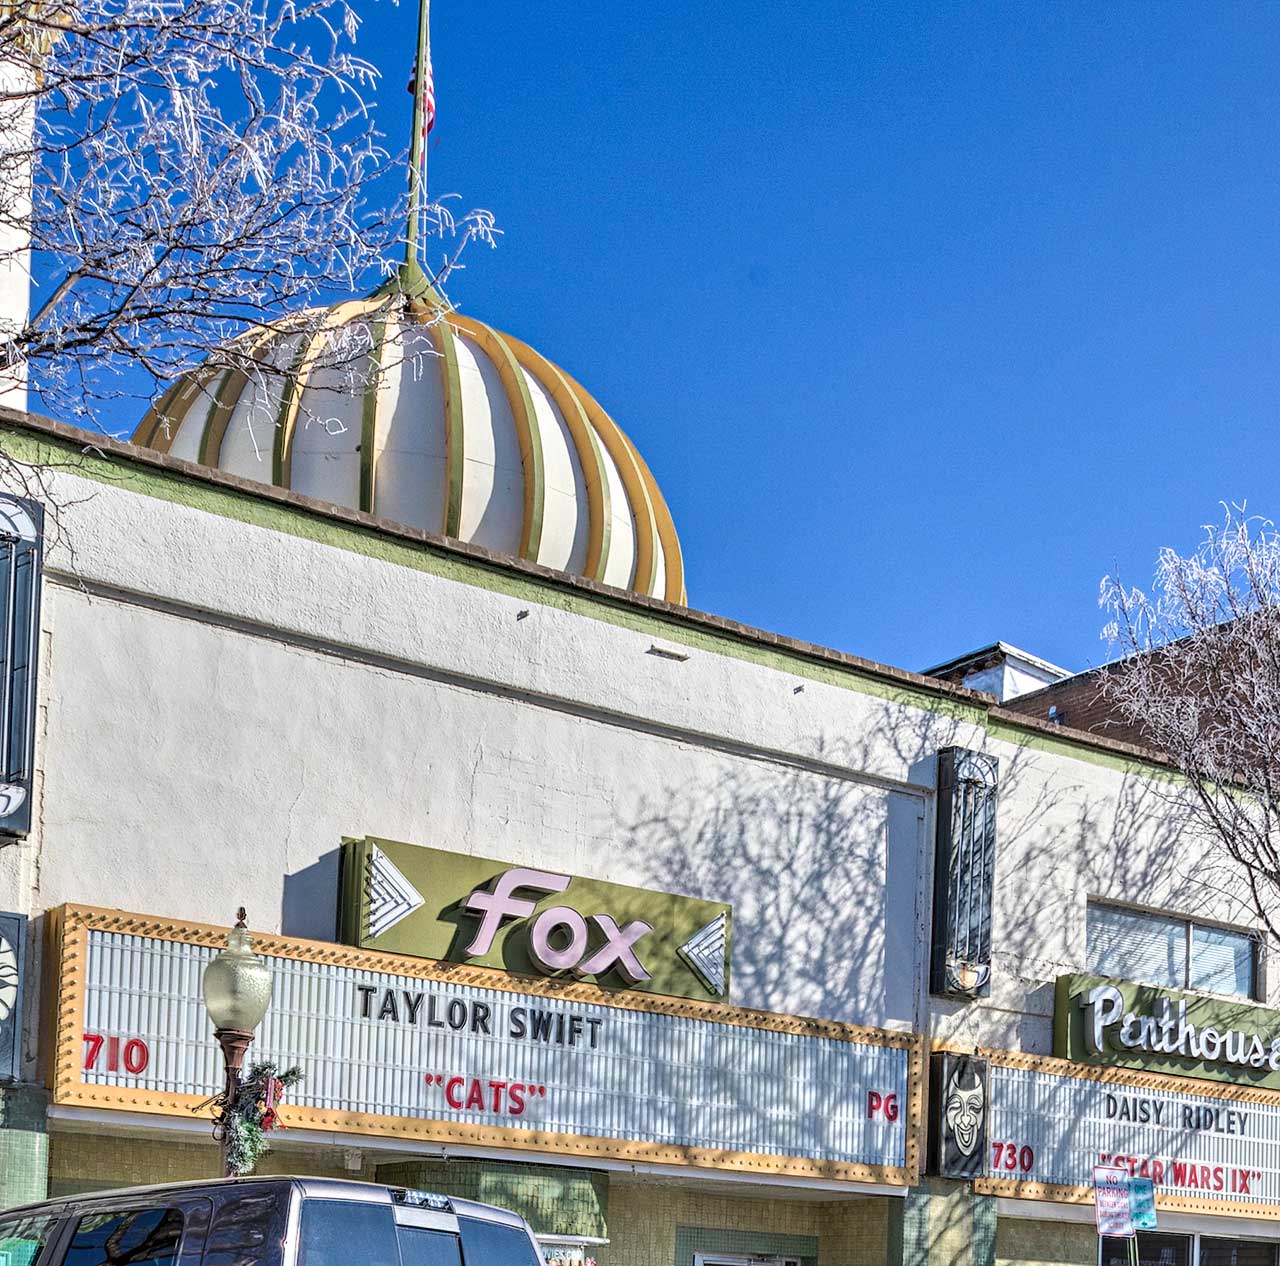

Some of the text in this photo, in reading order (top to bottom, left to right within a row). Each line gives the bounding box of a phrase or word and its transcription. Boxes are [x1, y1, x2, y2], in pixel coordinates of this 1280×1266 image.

[357, 984, 603, 1049] TAYLOR SWIFT
[82, 1033, 150, 1075] 710
[425, 1073, 547, 1116] "CATS"
[867, 1090, 900, 1122] PG
[1106, 1094, 1249, 1137] DAISY RIDLEY
[992, 1141, 1034, 1173] 730
[1105, 1175, 1119, 1186] NO
[1172, 1160, 1225, 1192] WARS
